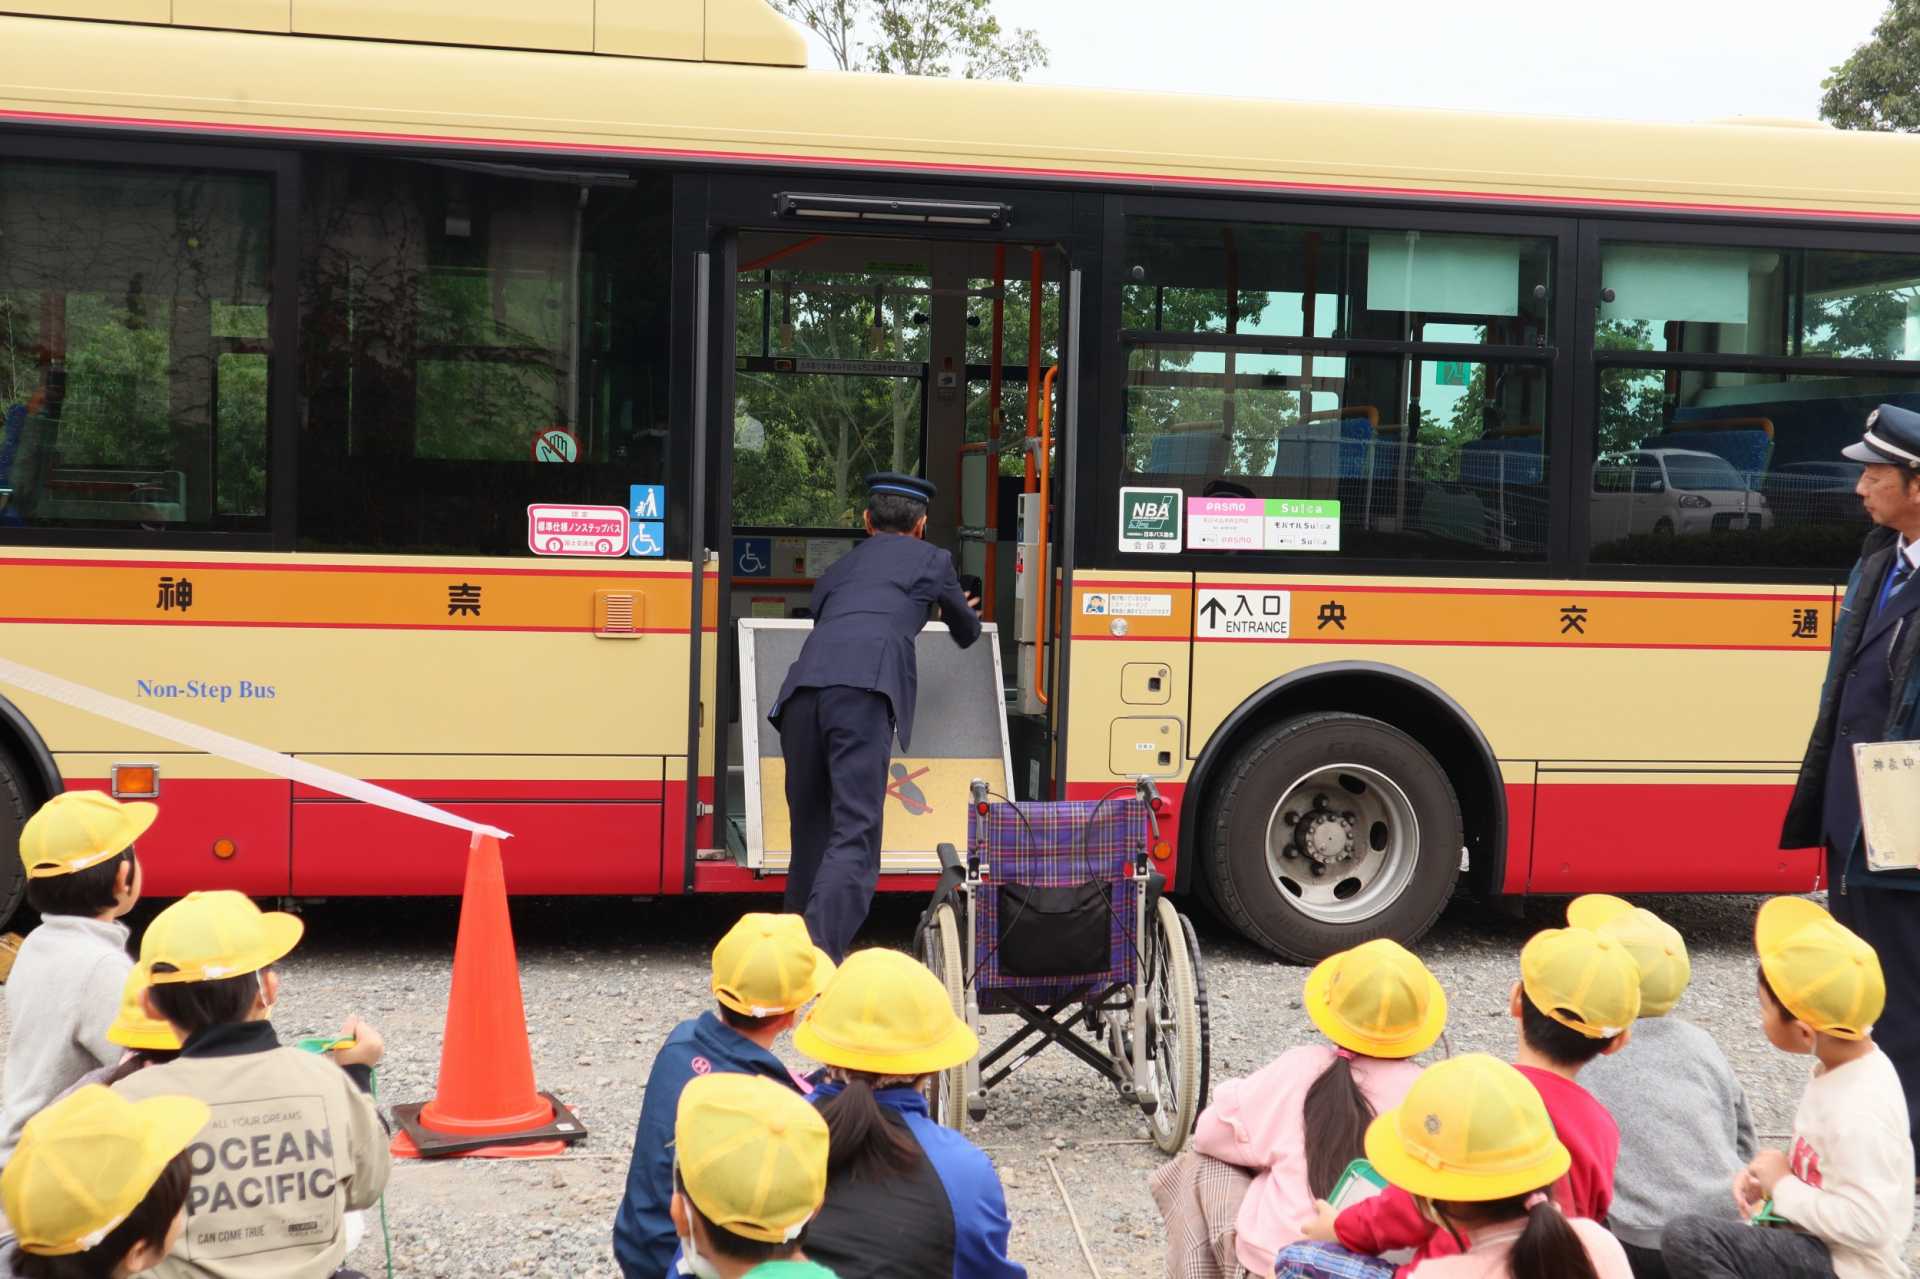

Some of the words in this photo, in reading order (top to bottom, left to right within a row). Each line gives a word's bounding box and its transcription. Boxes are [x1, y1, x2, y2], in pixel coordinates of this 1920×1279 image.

[1132, 501, 1170, 518] NBA
[1205, 502, 1246, 512] PASMO
[1281, 503, 1323, 513] Suica
[156, 576, 193, 612] 神
[1317, 600, 1347, 630] 央
[1560, 604, 1588, 634] 交
[1791, 608, 1819, 639] 通
[1233, 594, 1281, 617] 入口
[1226, 620, 1287, 634] ENTRANCE
[136, 679, 233, 703] Non-Step
[238, 680, 276, 699] Bus
[232, 1115, 261, 1128] YOUR
[262, 1111, 303, 1125] DREAMS
[187, 1128, 334, 1175] OCEAN
[185, 1168, 336, 1217] PACIFIC
[197, 1231, 217, 1245] CAN
[217, 1228, 243, 1242] COME
[245, 1225, 265, 1238] TRUE
